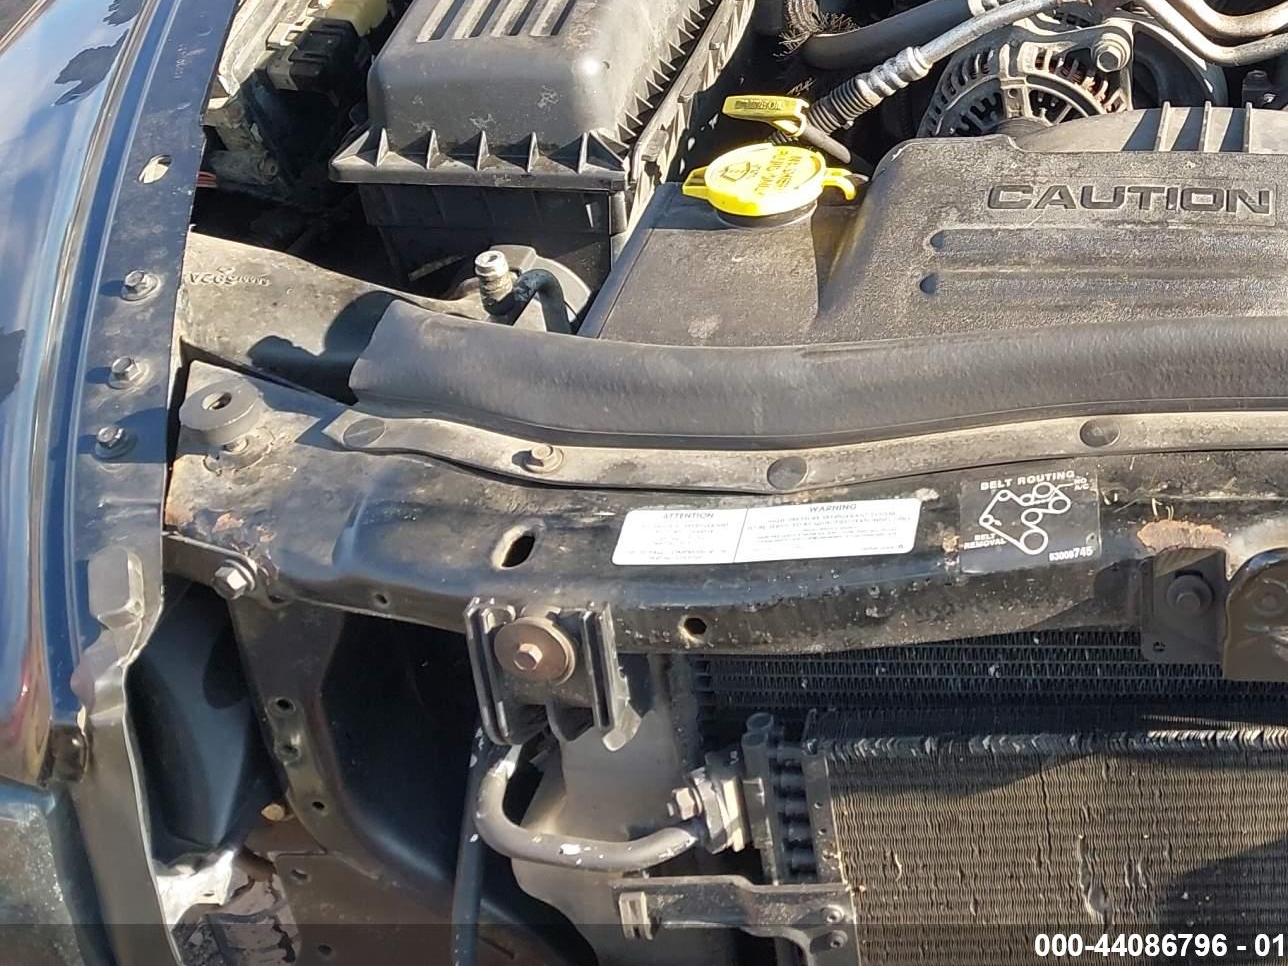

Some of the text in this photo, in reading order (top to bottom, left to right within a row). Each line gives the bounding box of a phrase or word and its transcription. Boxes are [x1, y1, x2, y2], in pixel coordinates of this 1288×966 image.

[986, 184, 1274, 215] CAUTION
[980, 470, 1076, 491] BELT ROUTING
[809, 503, 857, 513] WARNING
[963, 538, 1007, 549] REMOVAL
